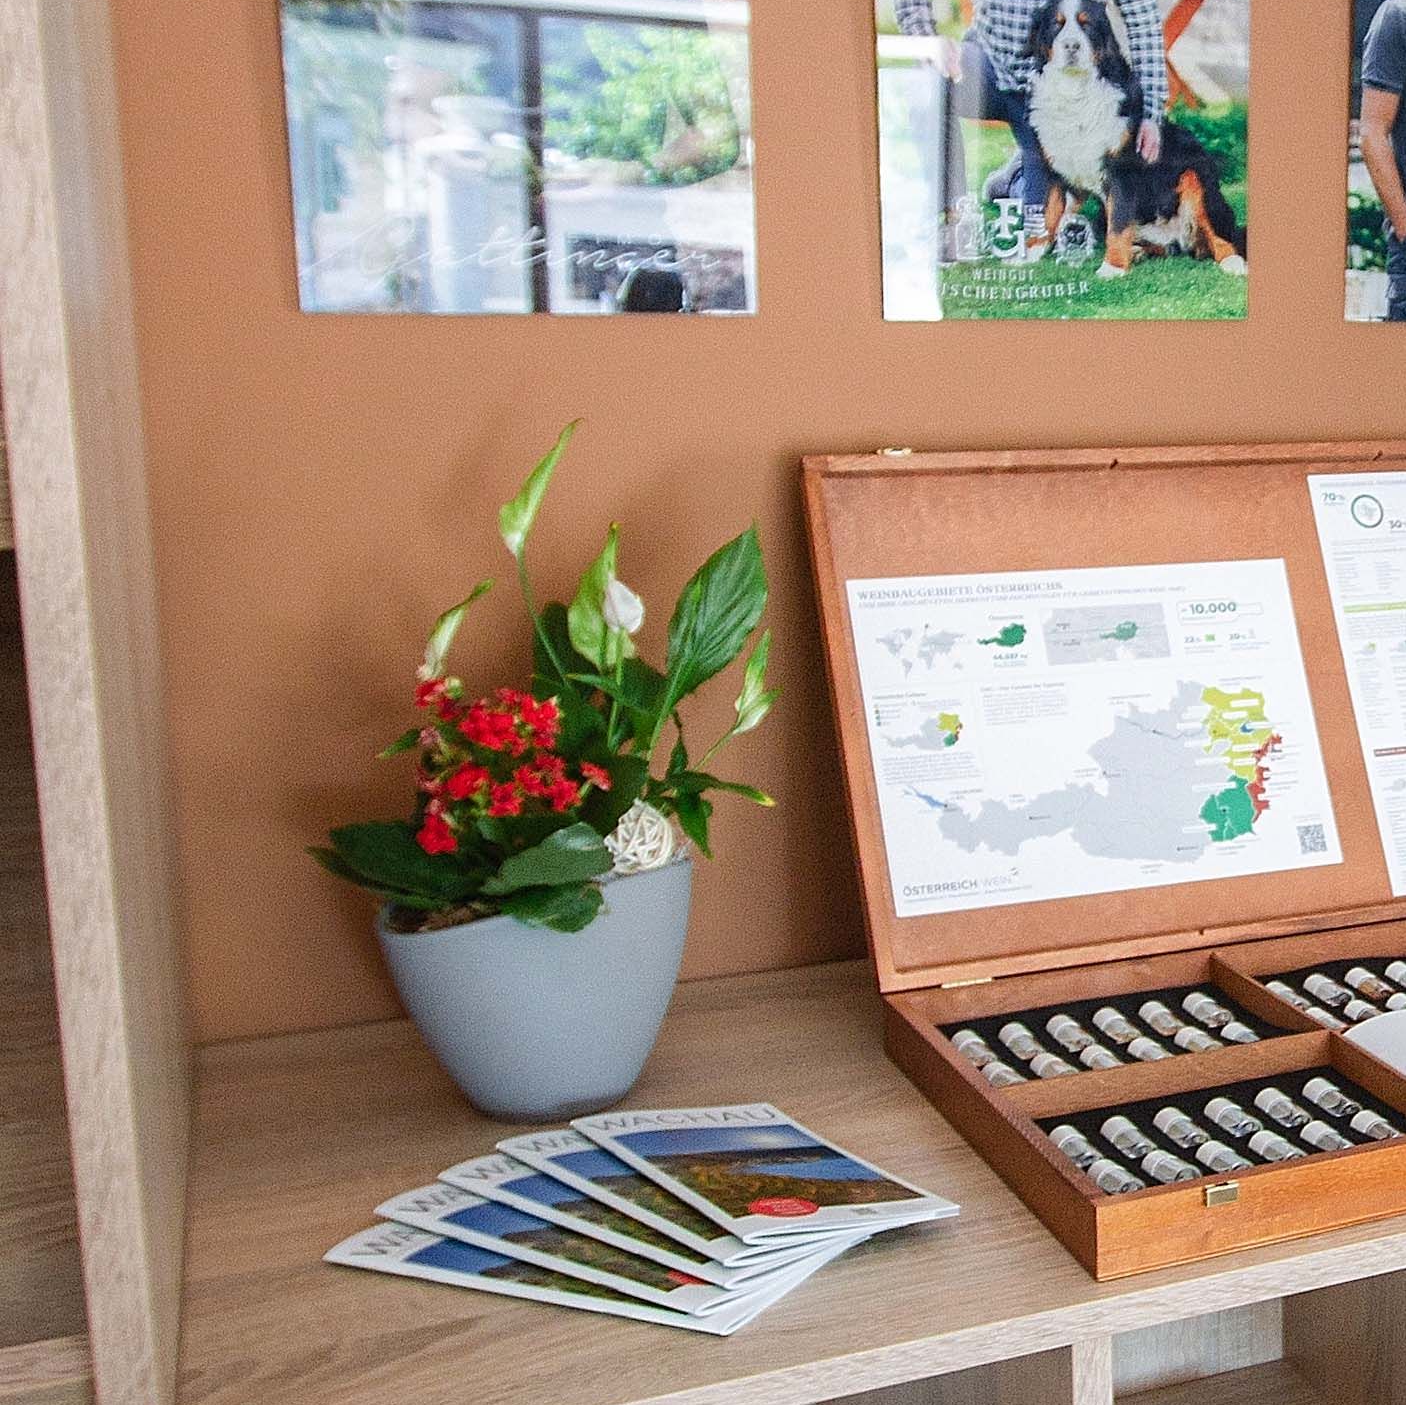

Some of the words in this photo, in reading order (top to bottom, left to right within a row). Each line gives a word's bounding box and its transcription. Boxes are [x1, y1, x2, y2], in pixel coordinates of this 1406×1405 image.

[973, 268, 1034, 280] WEINGUT
[941, 281, 1090, 300] ISCHENGRUBER
[858, 587, 974, 601] WEINBAUGEBIETE
[977, 581, 1063, 595] ÖSTERREICHS
[903, 880, 978, 897] ÖSTERREICH
[590, 1107, 776, 1131] WACHAU
